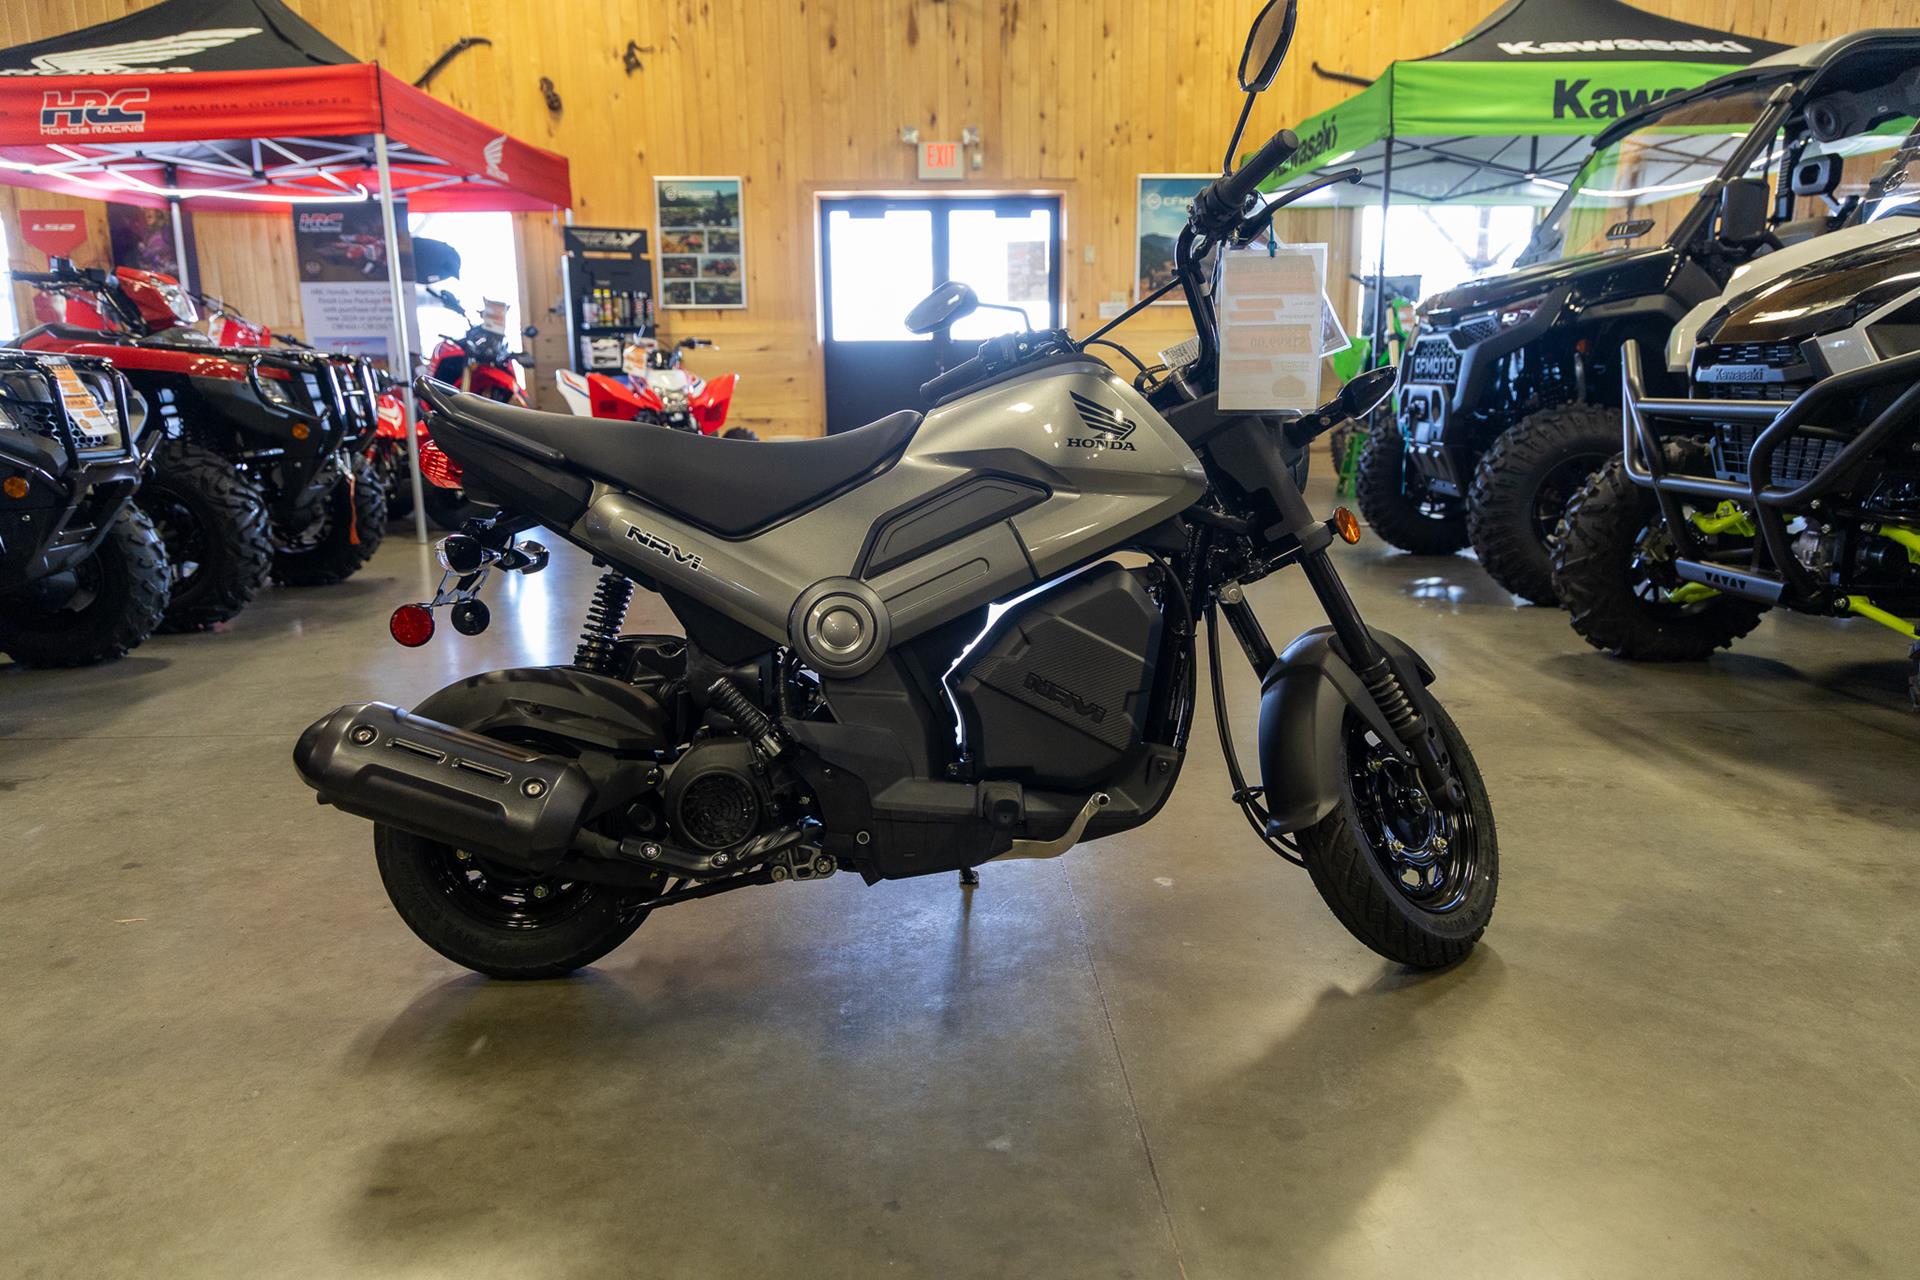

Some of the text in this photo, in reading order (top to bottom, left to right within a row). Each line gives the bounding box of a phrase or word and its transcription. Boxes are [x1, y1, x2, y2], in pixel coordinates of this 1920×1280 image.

[1497, 39, 1753, 54] Kawasaki
[41, 88, 150, 127] HRC
[40, 124, 145, 135] Honda RACING
[927, 144, 955, 168] EXIT
[1415, 356, 1457, 374] CFMOTO
[1715, 368, 1764, 381] Kawasaki
[1066, 438, 1137, 452] HONDA
